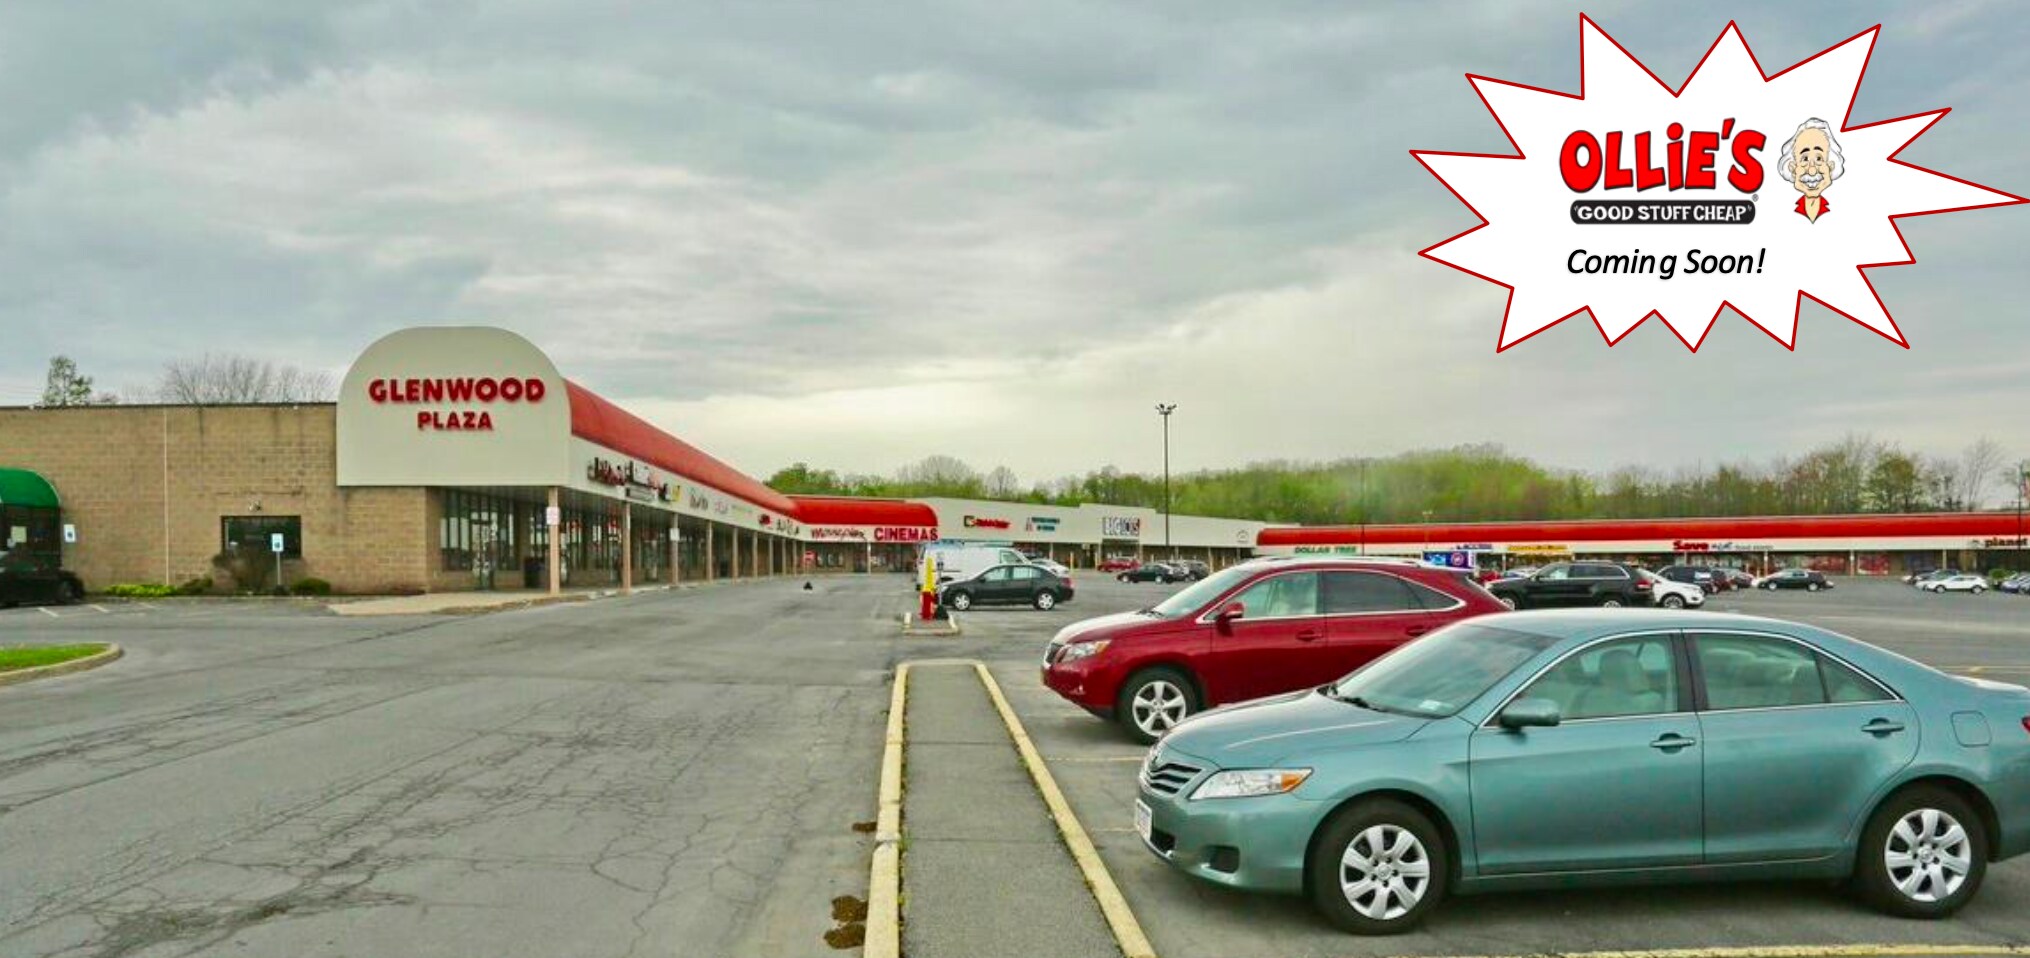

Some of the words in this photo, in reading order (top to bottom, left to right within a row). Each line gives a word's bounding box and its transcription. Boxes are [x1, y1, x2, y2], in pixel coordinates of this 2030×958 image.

[369, 377, 545, 403] GLENWOOD
[417, 411, 493, 431] PLAZA
[874, 527, 938, 541] CINEMAS
[1295, 546, 1330, 554] DOLLAR
